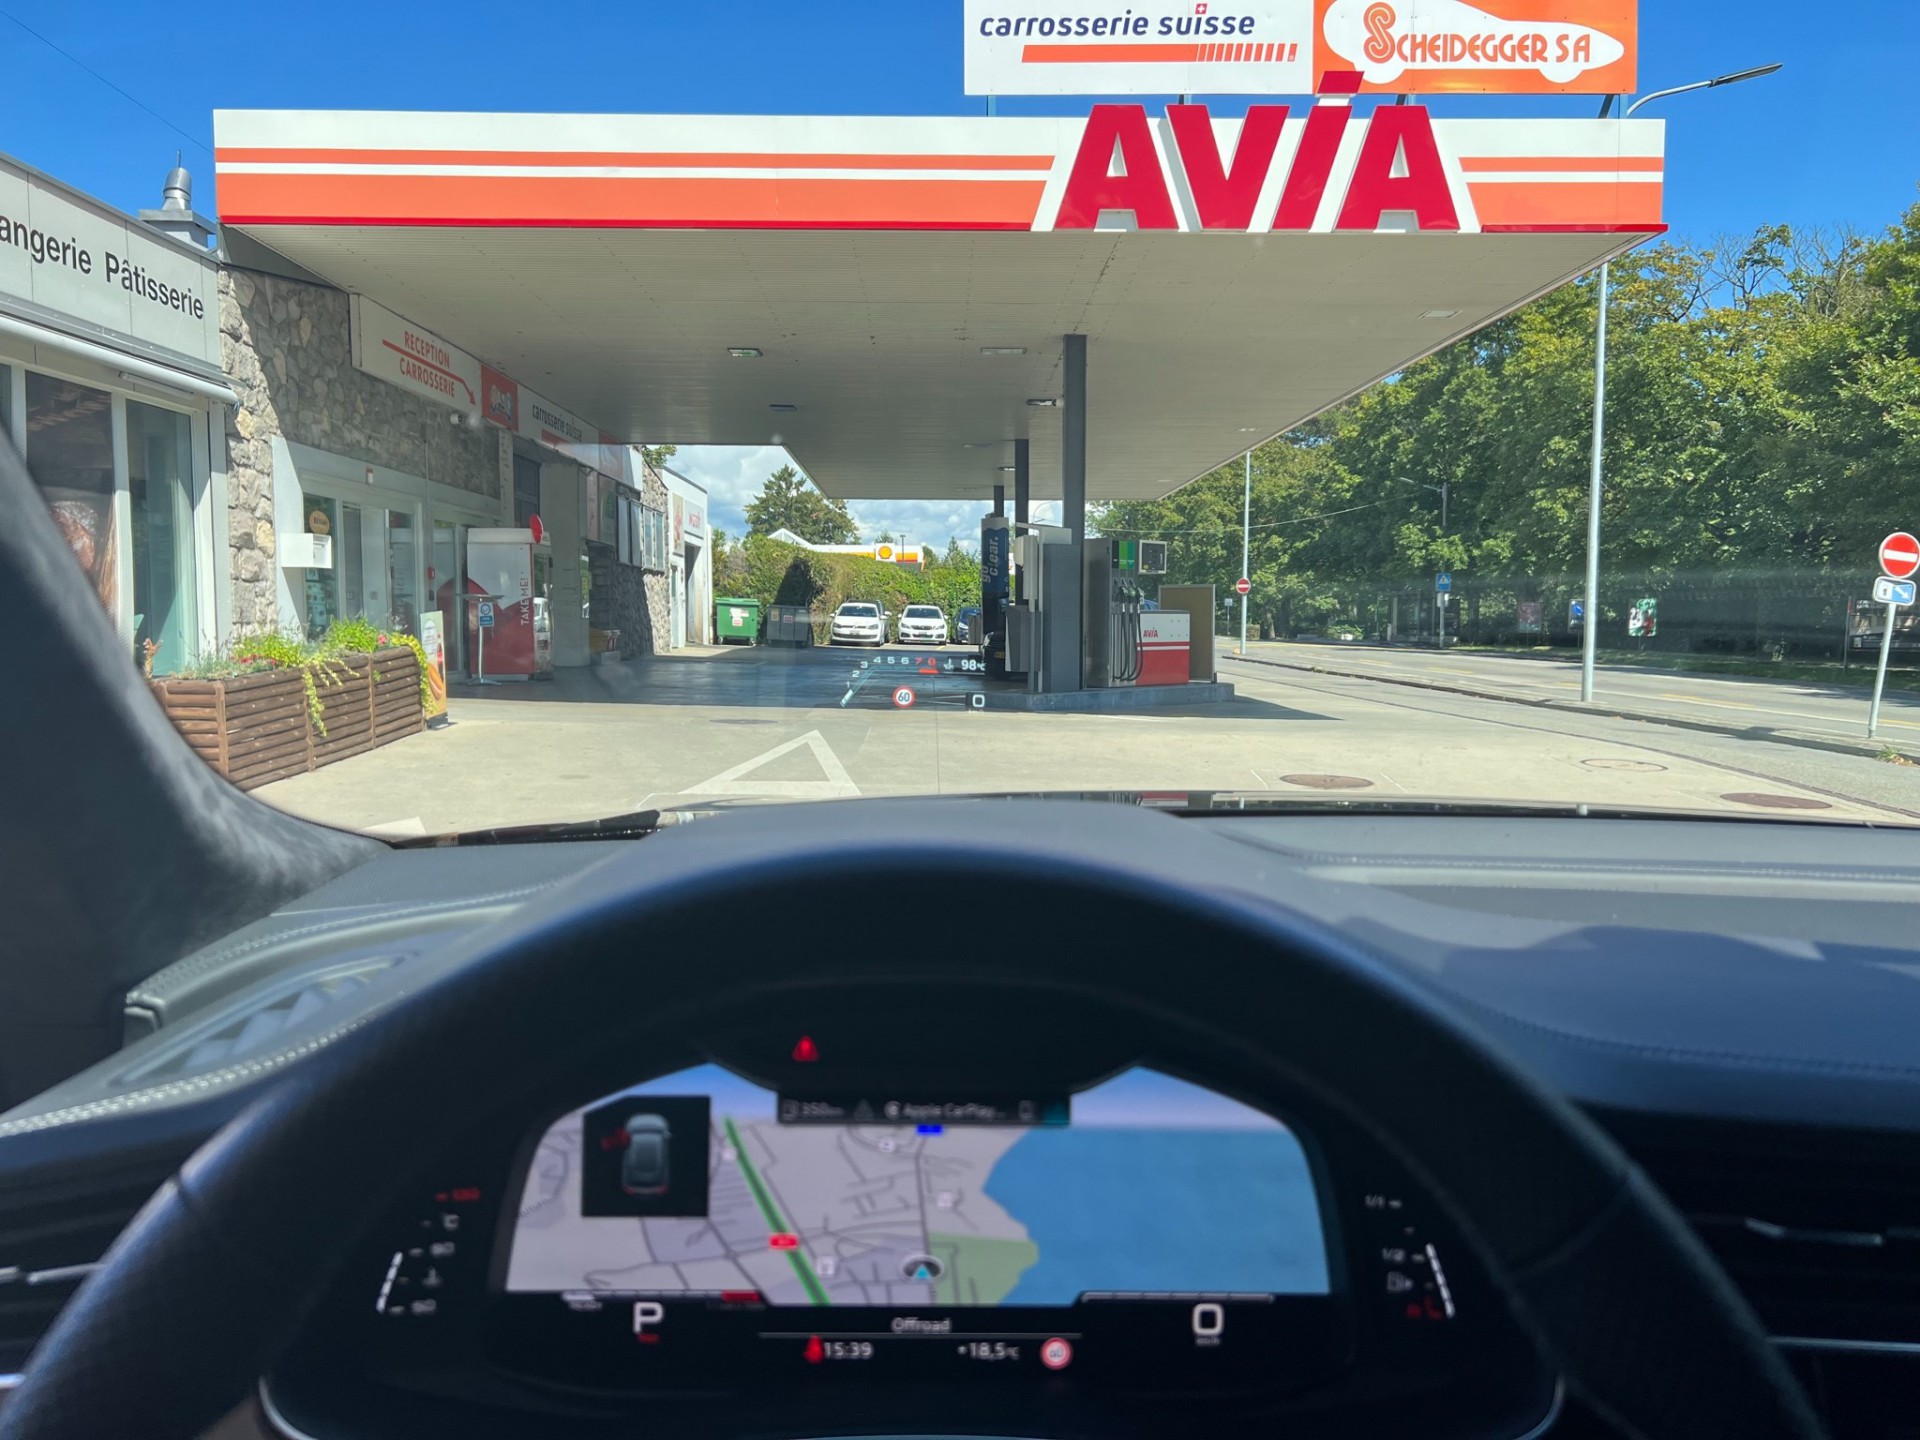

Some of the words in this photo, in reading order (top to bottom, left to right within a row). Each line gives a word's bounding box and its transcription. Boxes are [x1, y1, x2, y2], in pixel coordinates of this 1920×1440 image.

[979, 10, 1148, 37] carrosserie
[1157, 4, 1255, 35] suisse
[1363, 2, 1549, 63] SCHEIDEGGER
[1054, 70, 1460, 231] AVIA
[105, 251, 204, 320] Pâtisserie
[404, 330, 450, 369] RECEPTION
[400, 357, 455, 398] CARROSSERIE
[532, 404, 565, 433] carrosserie
[565, 420, 582, 442] suisse
[521, 597, 529, 625] TAKE
[1143, 627, 1158, 638] AVIA
[899, 692, 910, 702] 60
[633, 1301, 664, 1333] P
[891, 1316, 950, 1333] Offroad
[824, 1342, 873, 1359] 15:39
